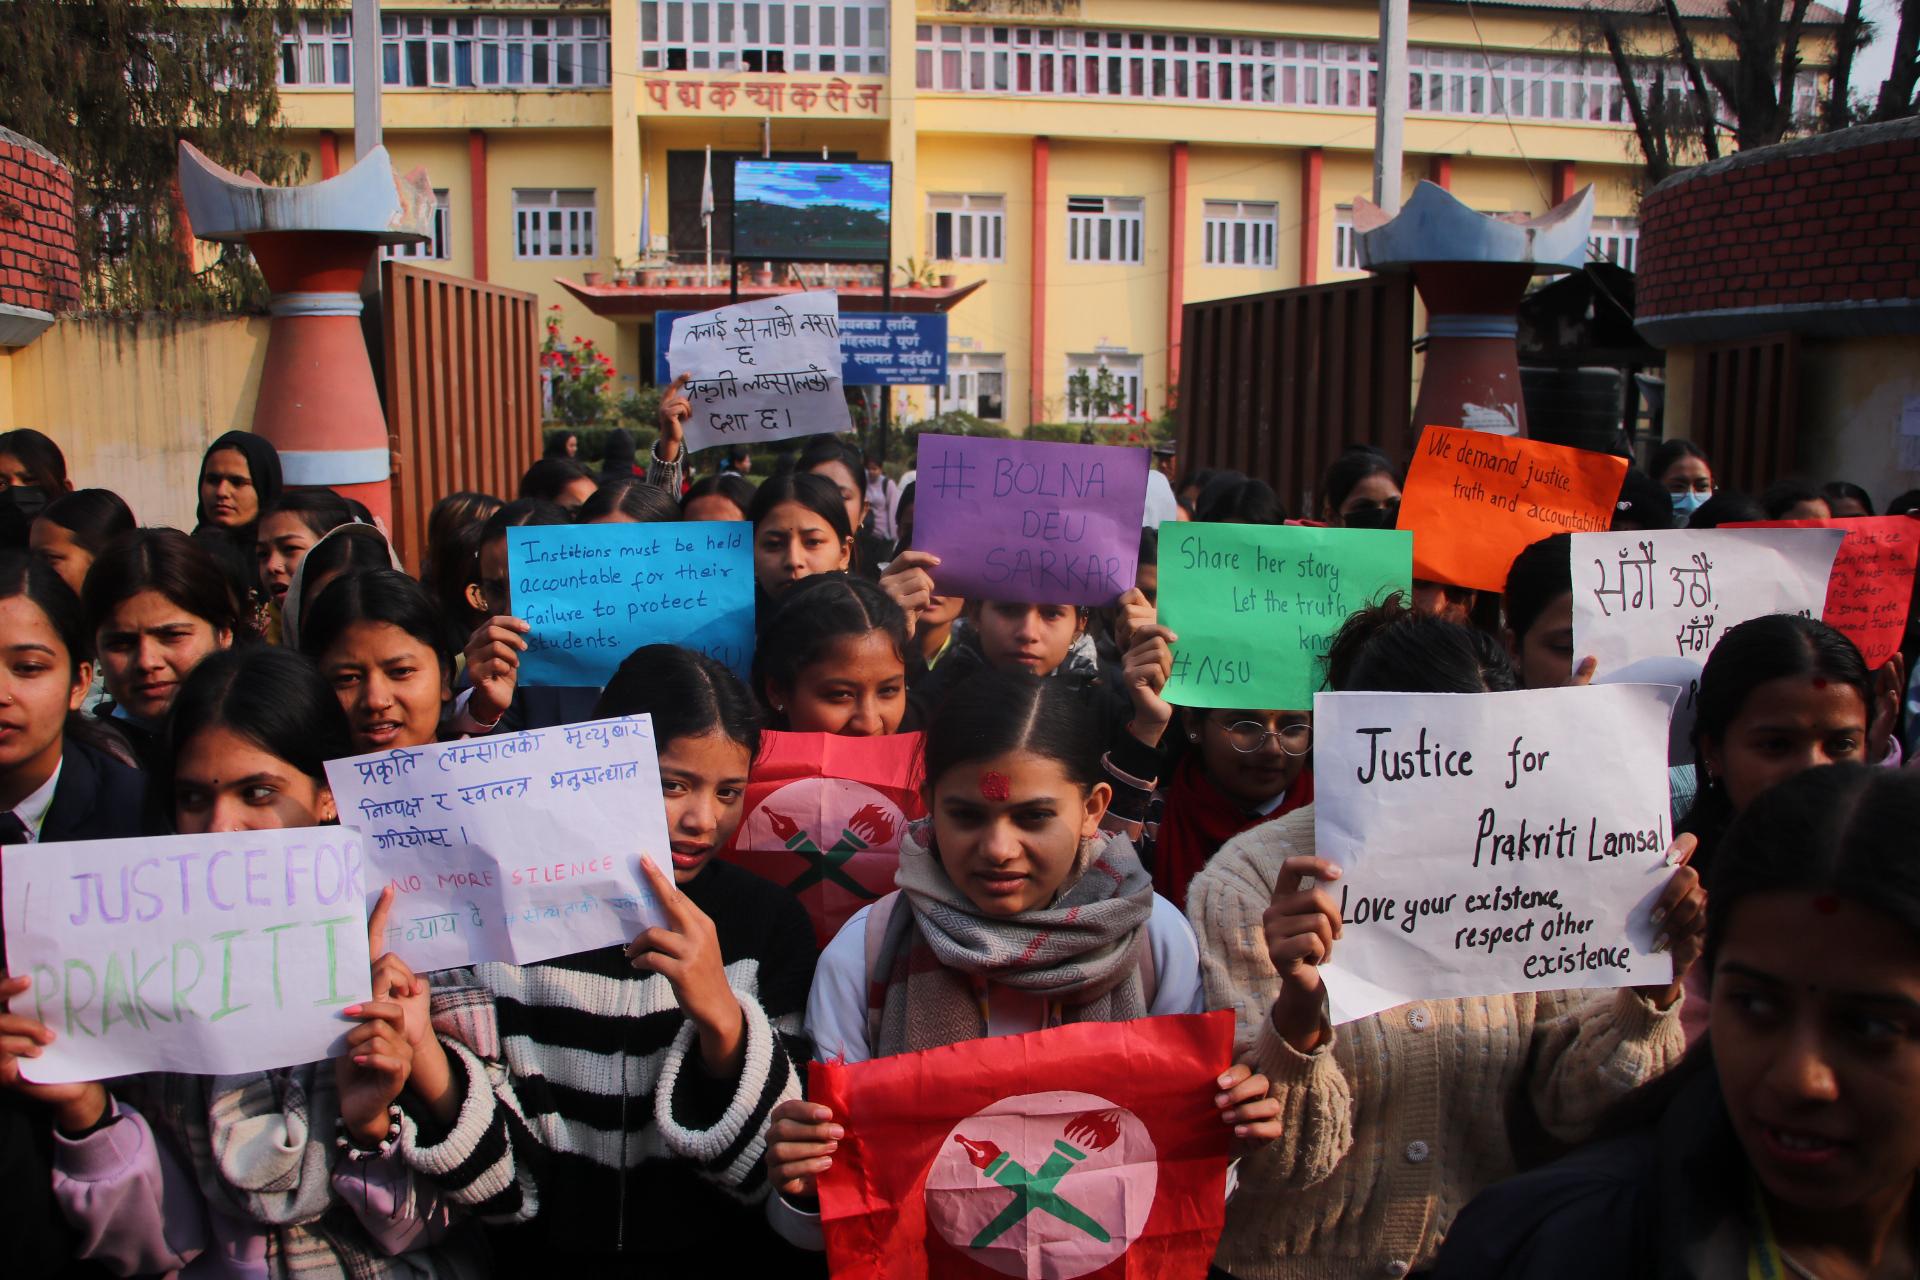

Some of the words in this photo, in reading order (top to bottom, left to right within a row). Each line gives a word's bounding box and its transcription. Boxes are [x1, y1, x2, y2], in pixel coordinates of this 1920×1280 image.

[726, 346, 756, 366] छ
[1428, 431, 1451, 458] We
[1457, 439, 1521, 476] demand
[993, 457, 1105, 498] BOLNA
[1454, 476, 1484, 502] truth
[1490, 493, 1519, 513] and
[1022, 509, 1086, 542] DEU
[619, 538, 661, 557] must
[675, 537, 695, 552] be
[706, 533, 742, 550] held
[520, 566, 623, 594] accountable
[631, 571, 664, 592] for
[675, 563, 734, 579] their
[1180, 536, 1240, 570] Share
[1256, 545, 1286, 573] her
[1297, 552, 1339, 593] story
[523, 604, 585, 625] failure
[592, 600, 616, 618] to
[627, 590, 709, 622] protect
[1233, 586, 1257, 613] Let
[1264, 590, 1288, 613] the
[1296, 592, 1346, 617] truth
[1299, 625, 1331, 650] kno
[354, 749, 423, 785] प्रकृति
[438, 732, 545, 772] लम्सालको
[1356, 727, 1473, 784] Justice
[1505, 735, 1550, 790] for
[431, 793, 452, 811] र
[458, 777, 532, 805] स्वतन्त्र
[1472, 807, 1578, 868] Prakriti
[1588, 814, 1666, 861] Lamsal
[284, 839, 364, 907] FOR
[391, 875, 421, 893] NO
[437, 870, 494, 888] MORE
[511, 855, 615, 885] SILENCE
[1341, 885, 1395, 924] Love
[1400, 893, 1456, 933] your
[1455, 919, 1535, 953] respect
[1541, 911, 1594, 941] other
[31, 915, 357, 1039] PRAKRITI
[1523, 942, 1631, 979] existence.
